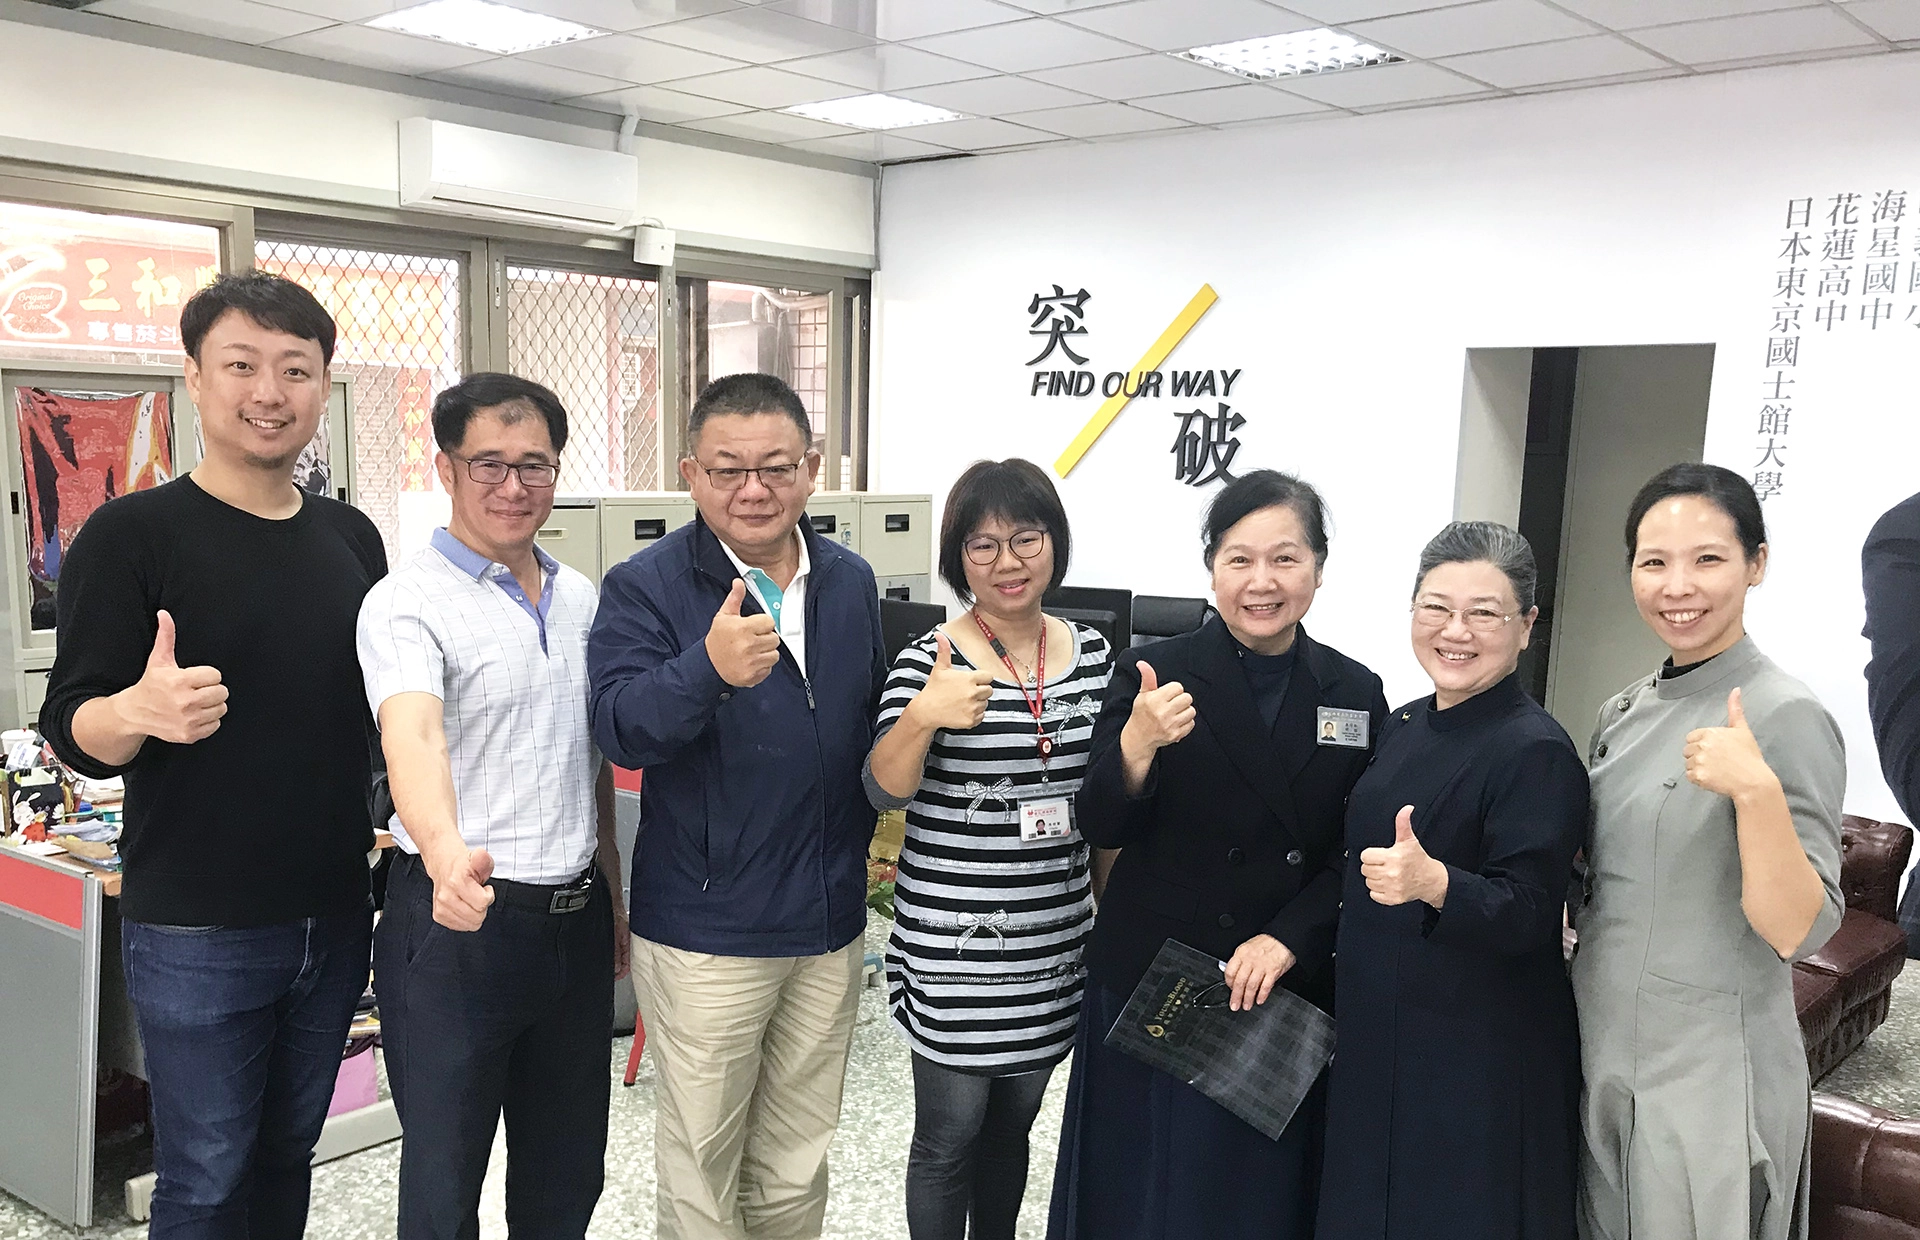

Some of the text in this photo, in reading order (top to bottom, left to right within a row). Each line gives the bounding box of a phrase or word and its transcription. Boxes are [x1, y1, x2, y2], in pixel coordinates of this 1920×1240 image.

[79, 257, 217, 318] 三和
[1815, 193, 1862, 331] 花蓮高中
[1860, 190, 1907, 330] 海星國中
[1025, 284, 1091, 366] 突
[1753, 197, 1813, 501] 日本東京國士館大學
[1031, 369, 1242, 398] FIND OUR WAY
[1170, 402, 1247, 487] 破
